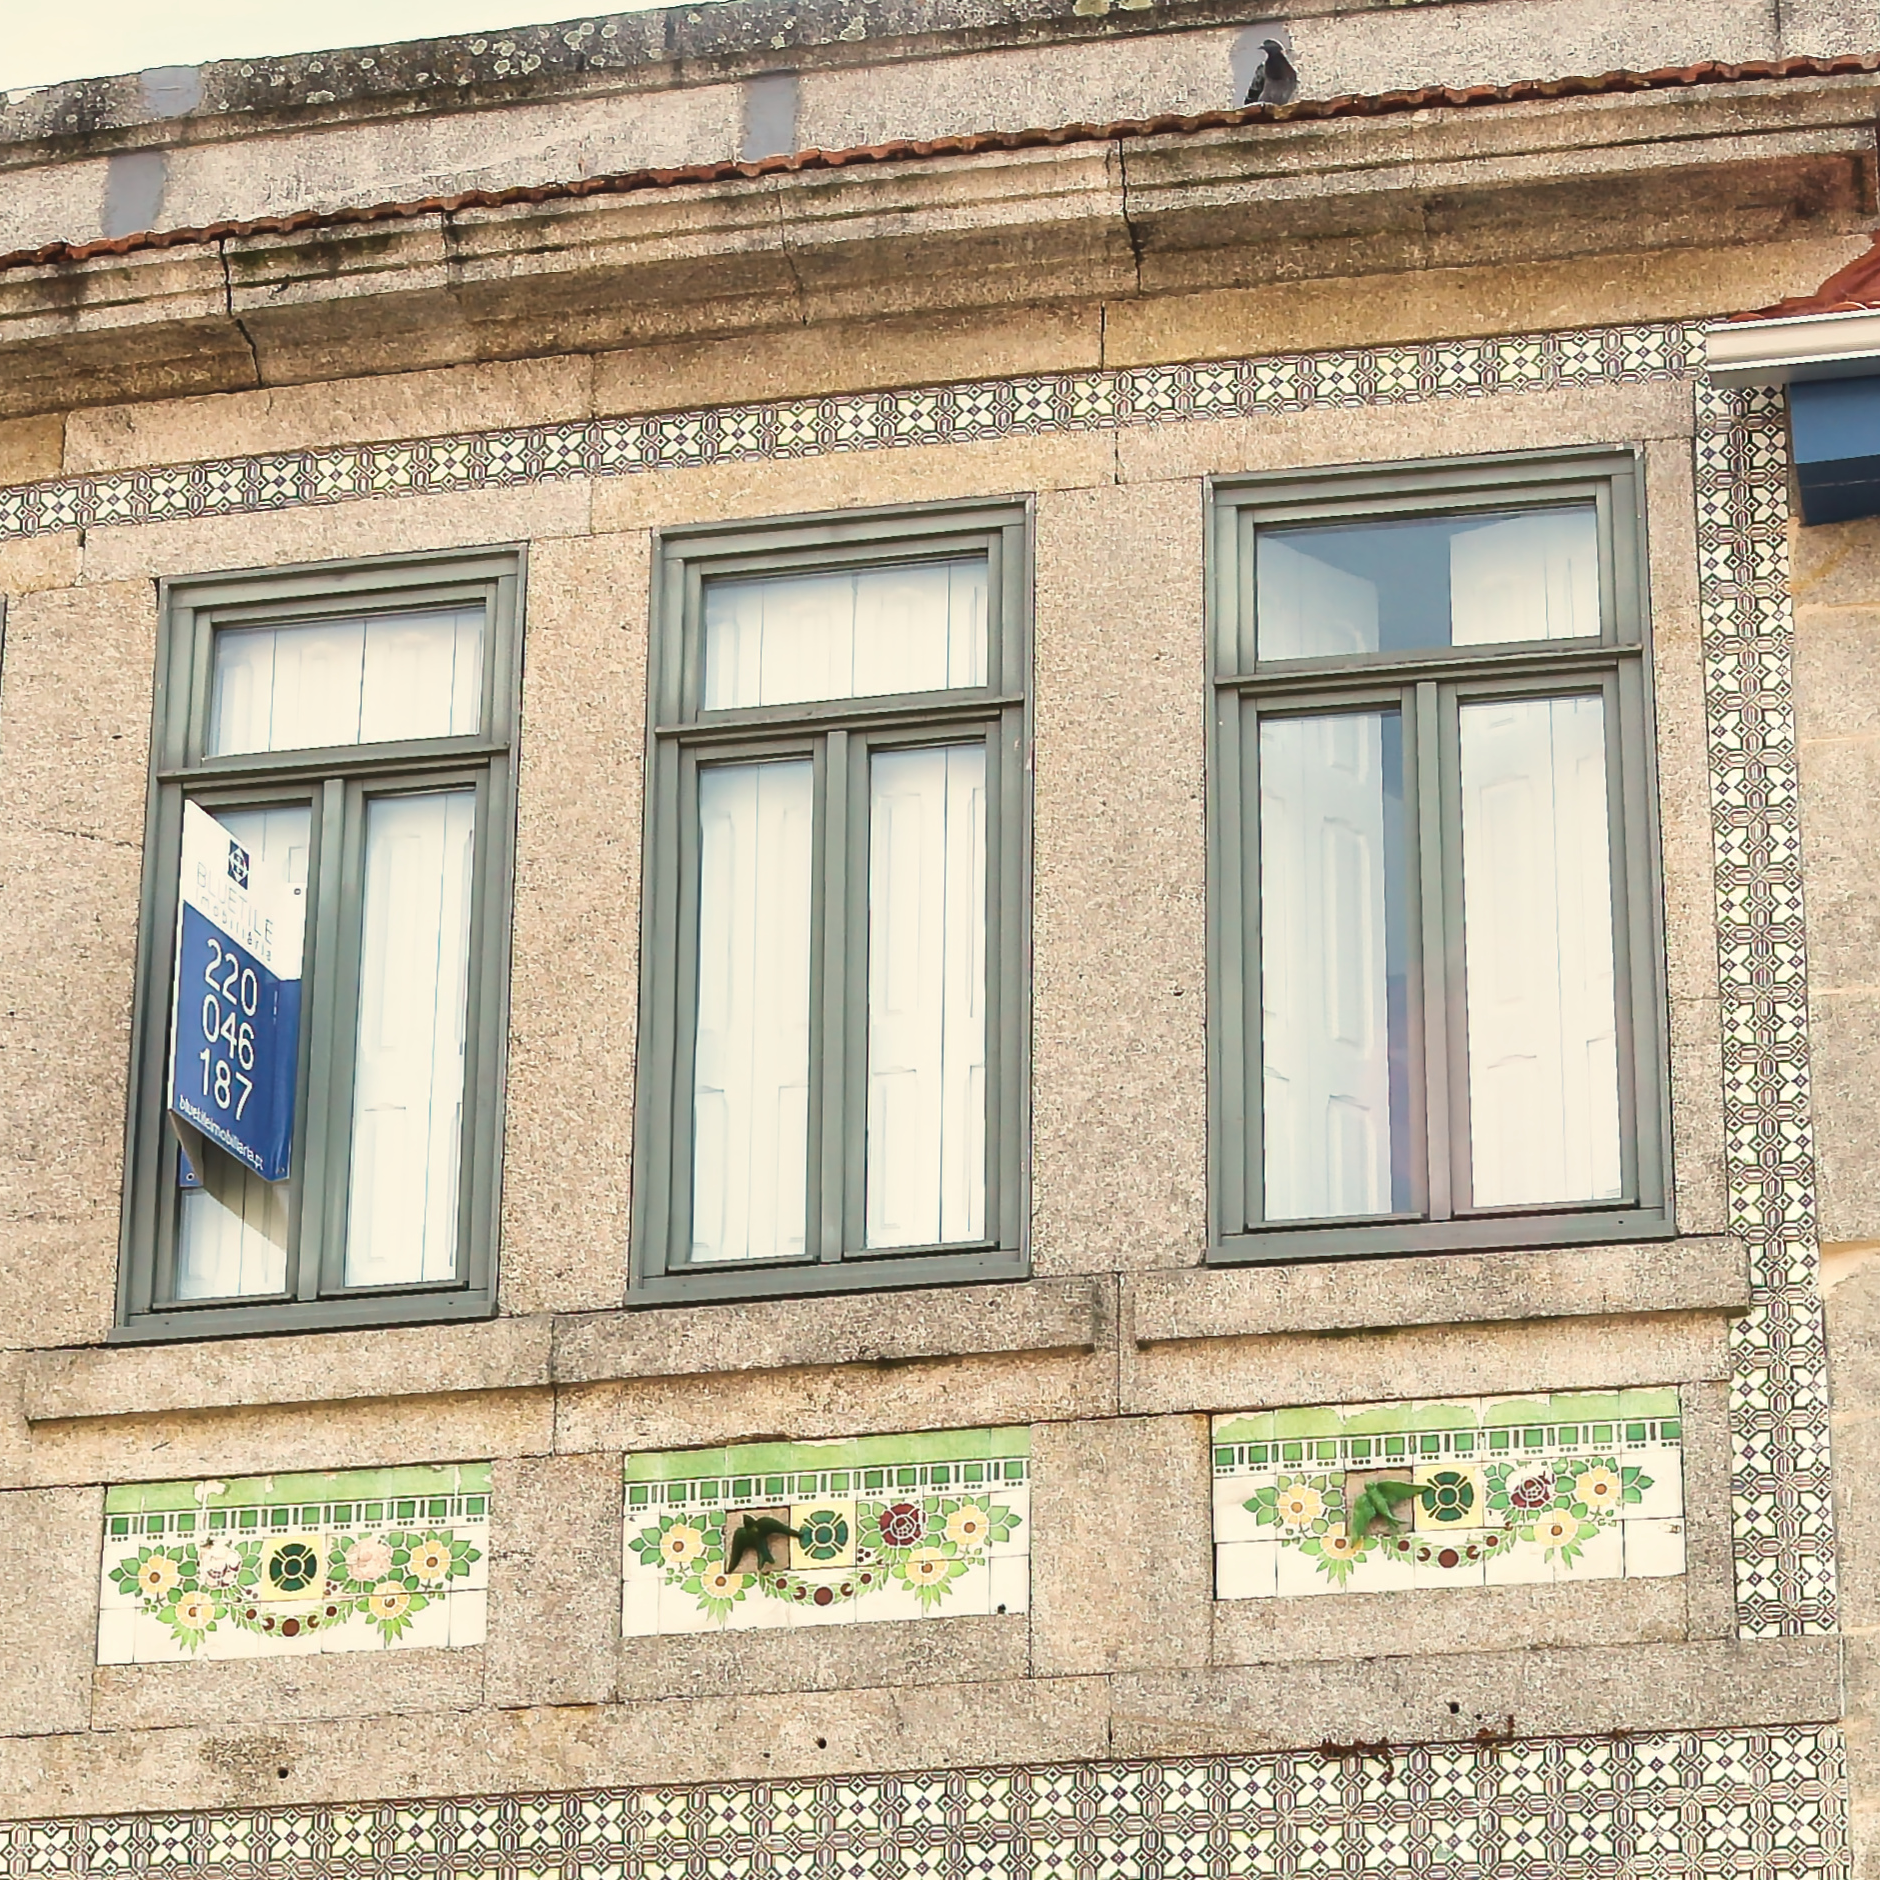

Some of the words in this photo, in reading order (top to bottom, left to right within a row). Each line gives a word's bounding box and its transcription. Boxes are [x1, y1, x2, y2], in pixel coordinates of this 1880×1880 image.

[196, 861, 274, 946] BLUETILE
[204, 938, 258, 1017] 220
[202, 993, 255, 1071] 046
[199, 1047, 253, 1121] 187
